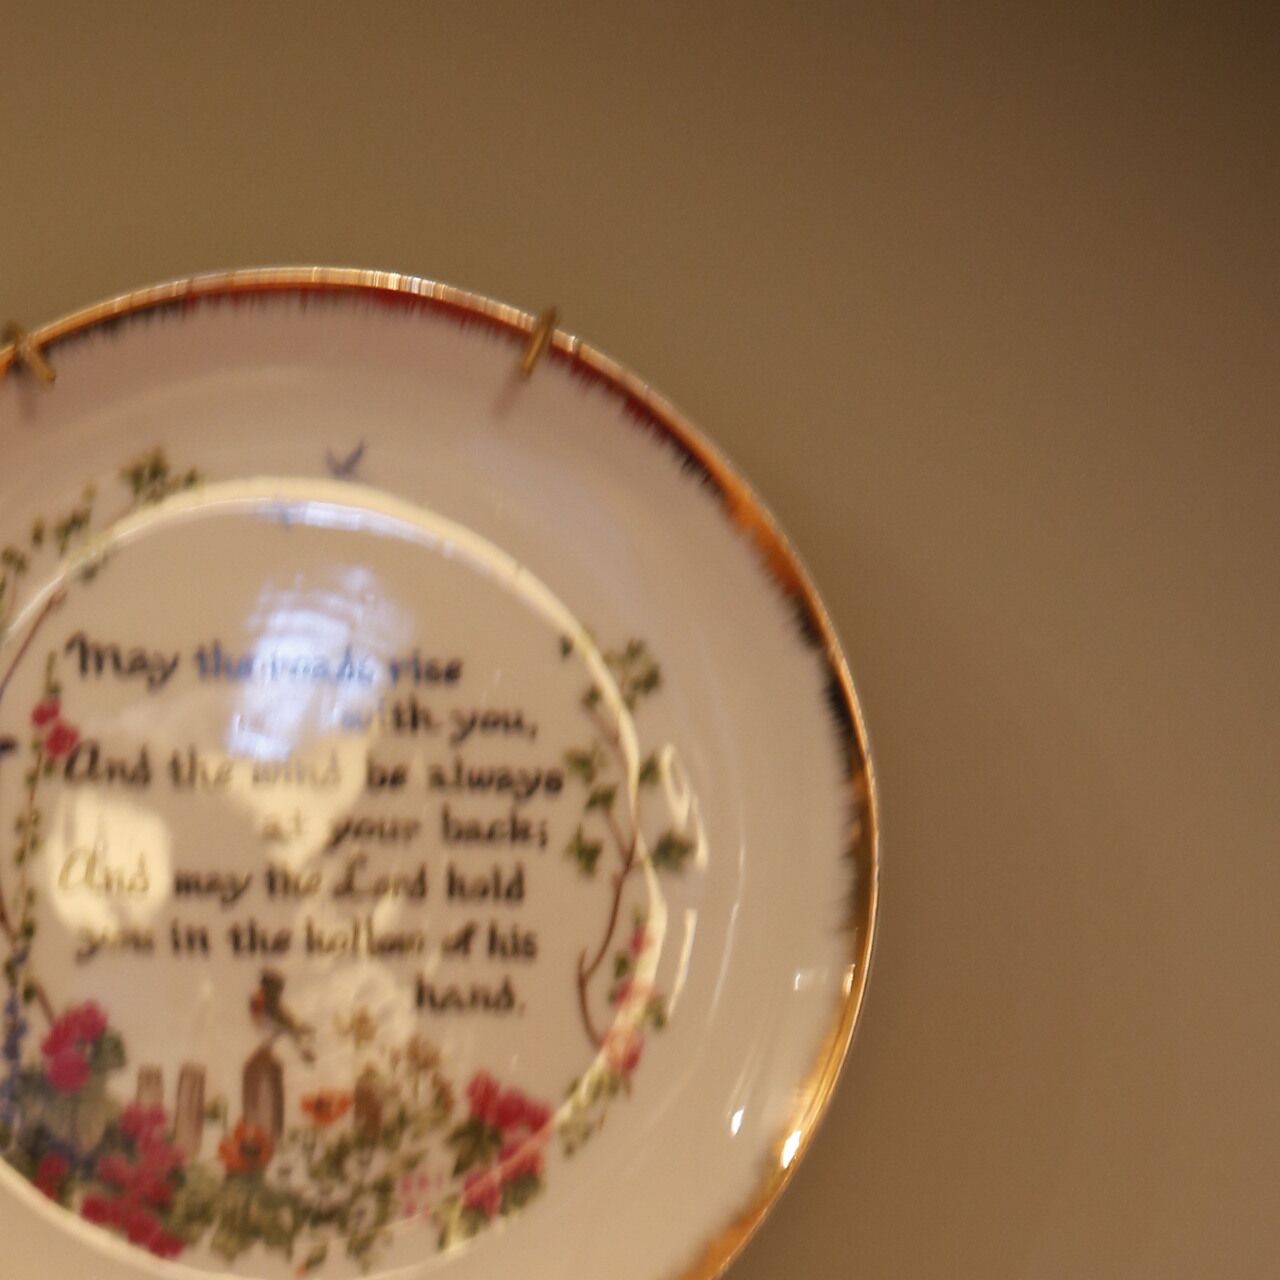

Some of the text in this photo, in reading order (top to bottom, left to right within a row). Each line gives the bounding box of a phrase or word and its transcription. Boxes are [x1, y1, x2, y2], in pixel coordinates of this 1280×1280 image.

[64, 631, 180, 691] May
[389, 649, 464, 686] rise
[62, 740, 152, 786] And
[166, 742, 234, 787] the
[365, 752, 409, 788] be
[428, 754, 565, 799] always
[326, 816, 424, 850] your
[57, 838, 526, 906] And may the Lord hold
[170, 918, 211, 956] in
[228, 917, 293, 956] the
[305, 915, 425, 958] hollow
[439, 922, 478, 957] of
[488, 917, 539, 959] his
